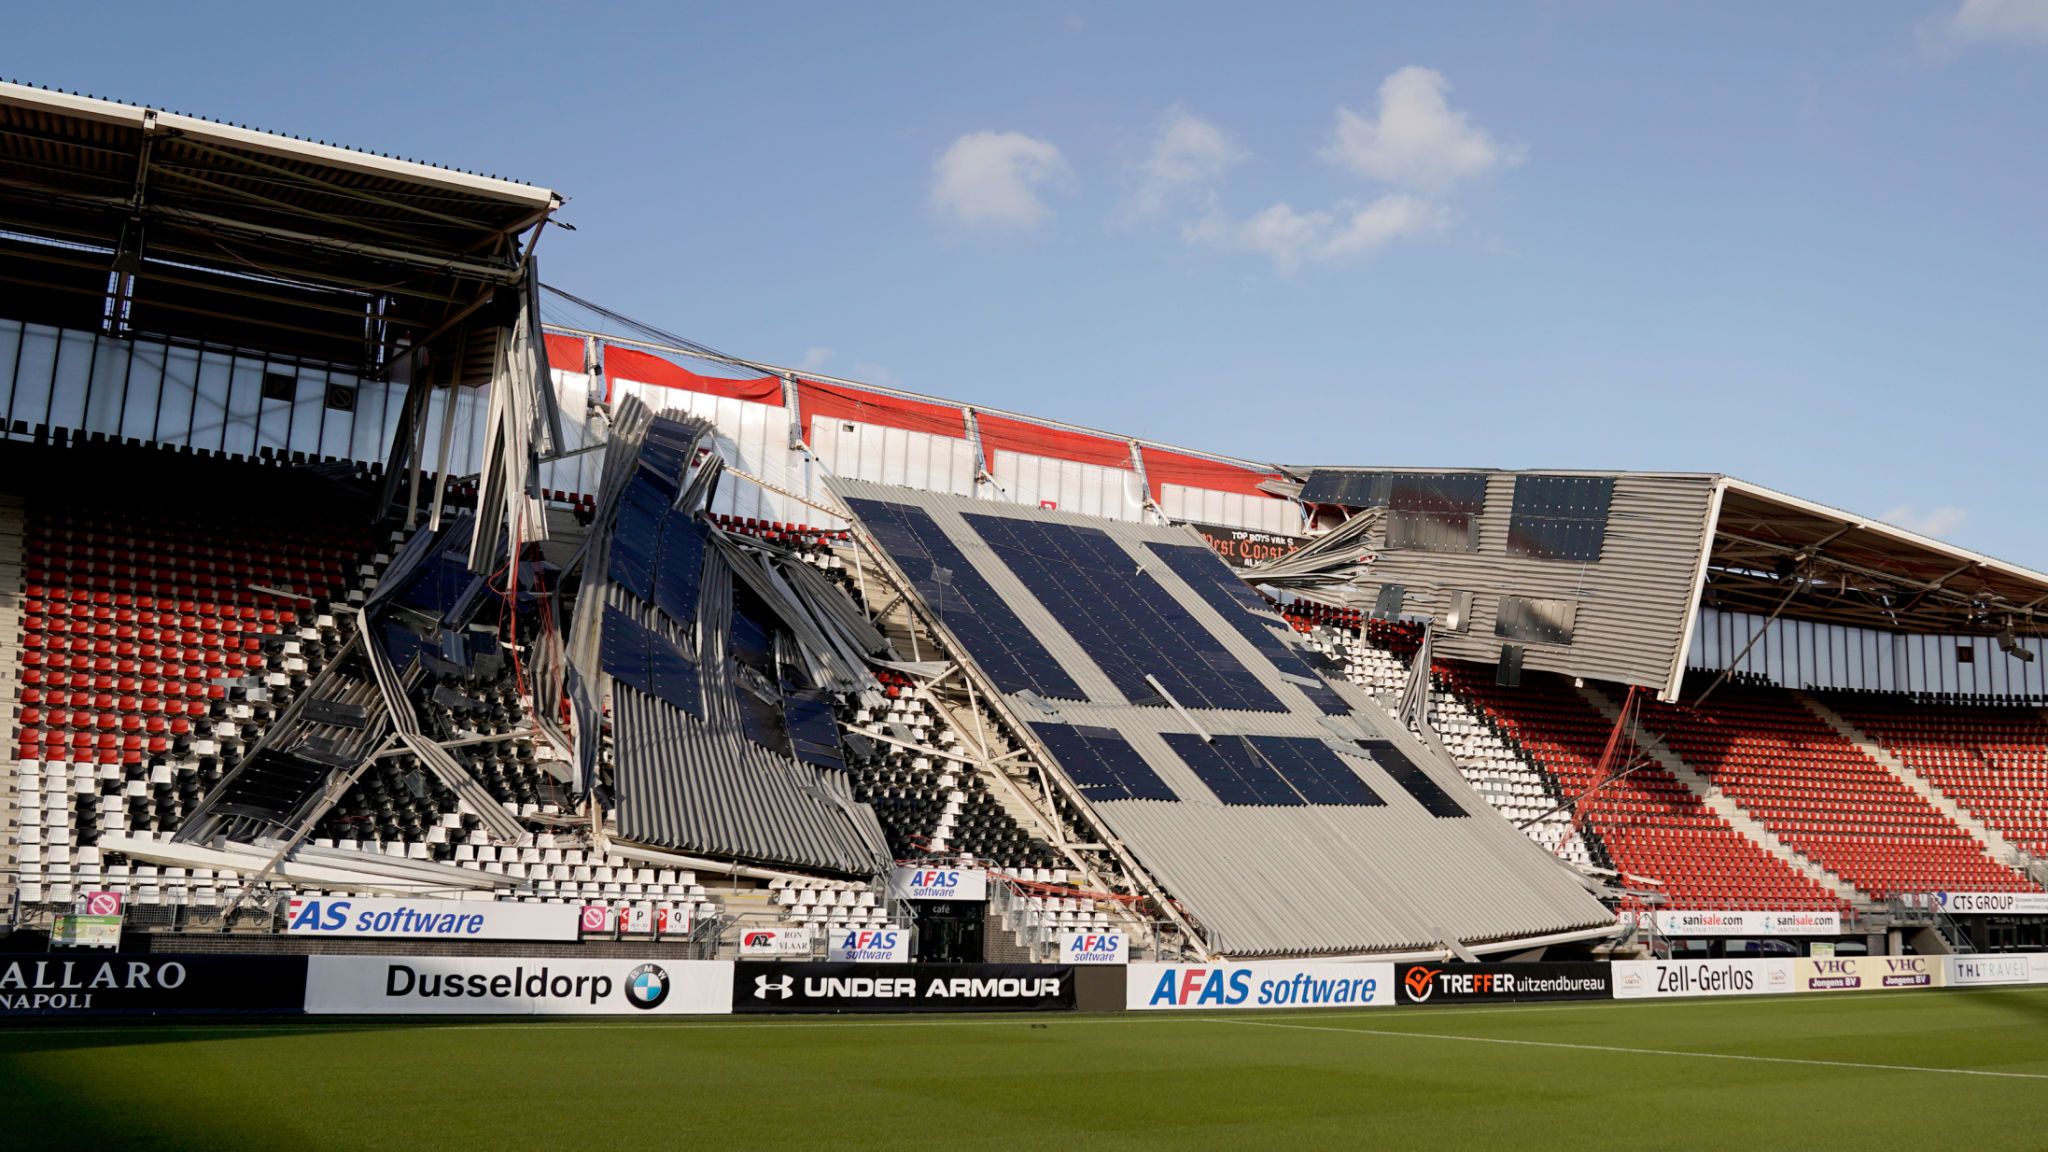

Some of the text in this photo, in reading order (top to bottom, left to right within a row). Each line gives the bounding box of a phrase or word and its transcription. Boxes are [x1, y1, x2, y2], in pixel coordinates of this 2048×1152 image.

[1231, 531, 1248, 540] TOP
[1249, 533, 1270, 543] BOYS
[1240, 539, 1284, 559] Coast
[910, 871, 960, 887] AFAS
[913, 887, 955, 897] software
[932, 904, 951, 914] café
[1953, 895, 1973, 910] CTS
[1975, 895, 2014, 910] GROUP
[355, 906, 484, 934] software
[636, 910, 644, 921] P
[674, 912, 682, 923] Q
[1683, 913, 1743, 926] sanisale.com
[1777, 914, 1833, 926] sanisale.com
[751, 935, 771, 947] AZ
[784, 931, 803, 939] RON
[842, 931, 898, 949] AFAS
[778, 942, 808, 950] VLAAR
[1071, 935, 1119, 952] AFAS
[845, 949, 892, 960] software
[1074, 951, 1115, 961] software
[630, 964, 667, 980] BMW
[1813, 960, 1856, 975] VHC
[1886, 958, 1926, 973] VHC
[0, 961, 186, 989] ALLARO
[1656, 965, 1754, 992] Zell-Gerlos
[1885, 975, 1926, 986] Jongens BV
[386, 964, 613, 1005] Dusseldorp
[804, 977, 1060, 998] UNDER ARMOUR
[1149, 969, 1377, 1005] AFAS software
[1440, 974, 1515, 994] TREFFER
[1517, 975, 1605, 992] uitzendbureau
[1812, 977, 1857, 989] Jongens BV
[0, 993, 93, 1009] NAPOLI
